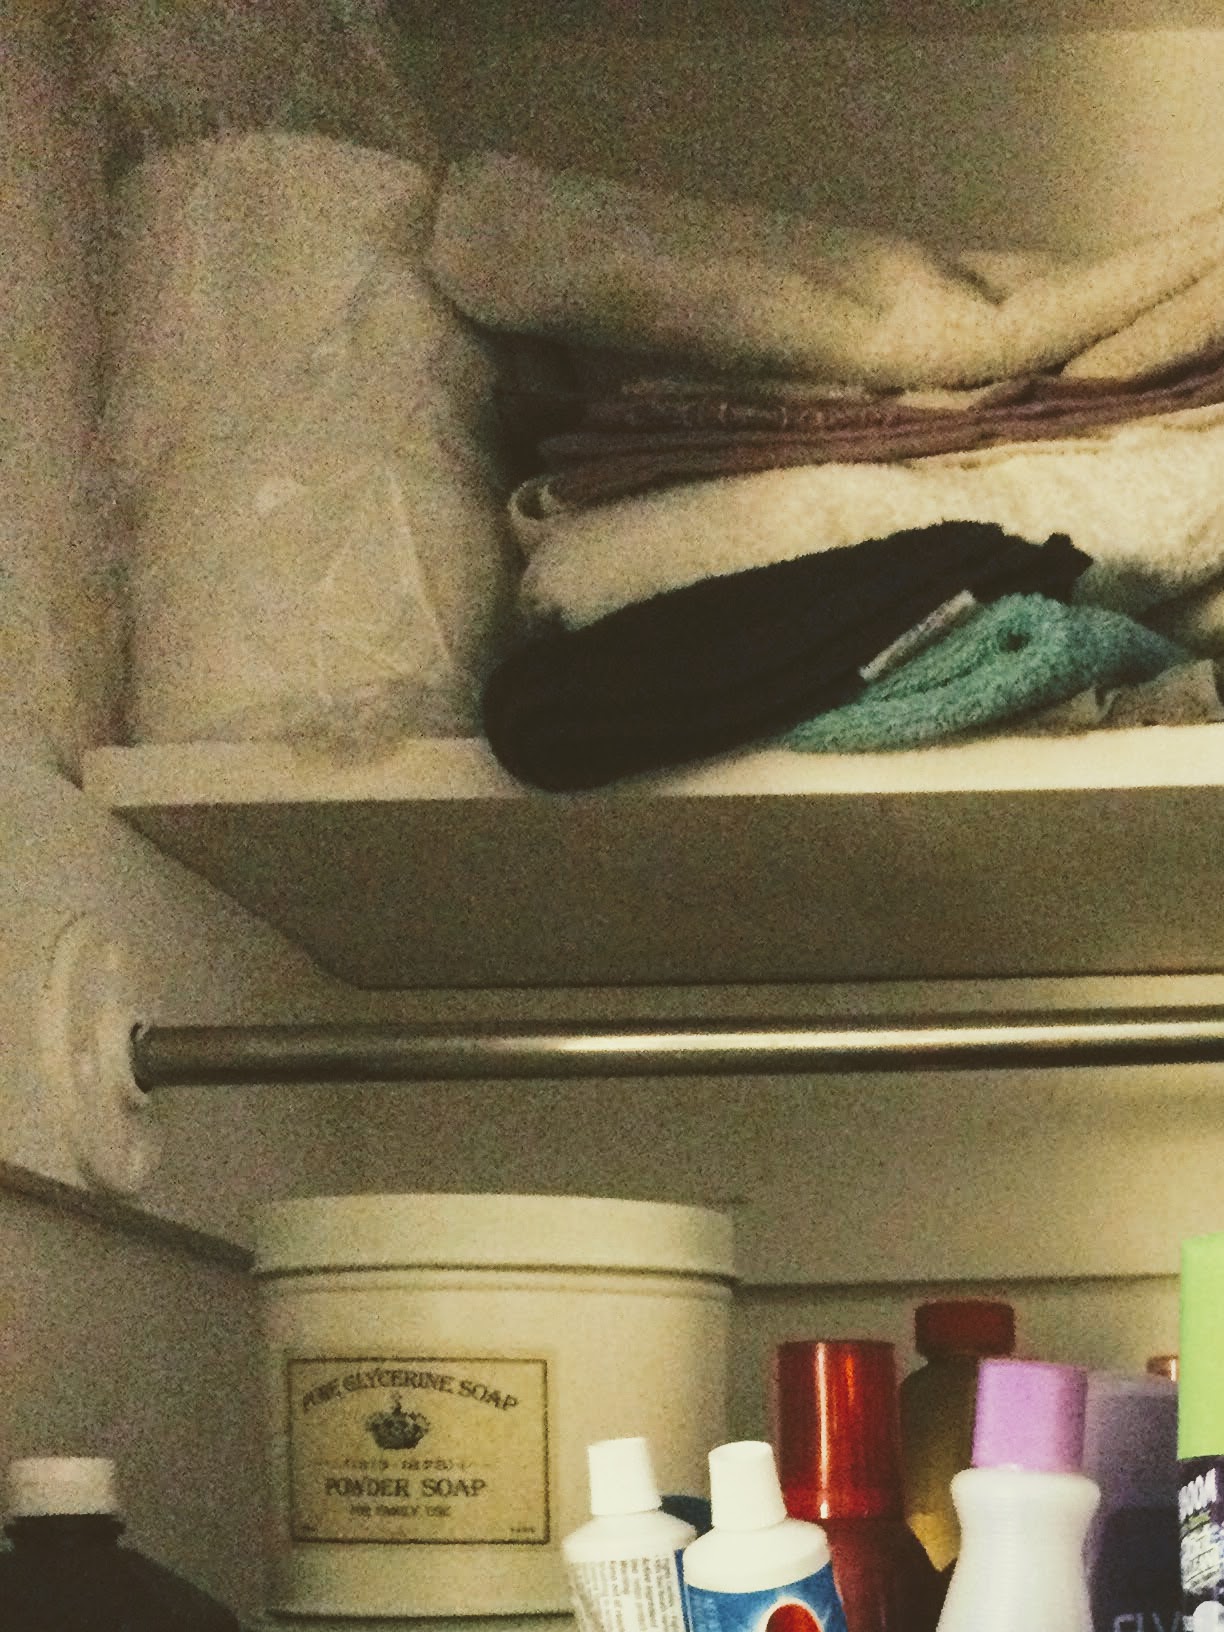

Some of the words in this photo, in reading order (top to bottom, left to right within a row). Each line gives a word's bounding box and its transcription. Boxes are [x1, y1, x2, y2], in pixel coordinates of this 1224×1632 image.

[342, 1367, 456, 1395] GLYCERINE
[456, 1379, 520, 1411] SOAP
[324, 1478, 411, 1498] POWDER
[420, 1477, 488, 1498] SOAP
